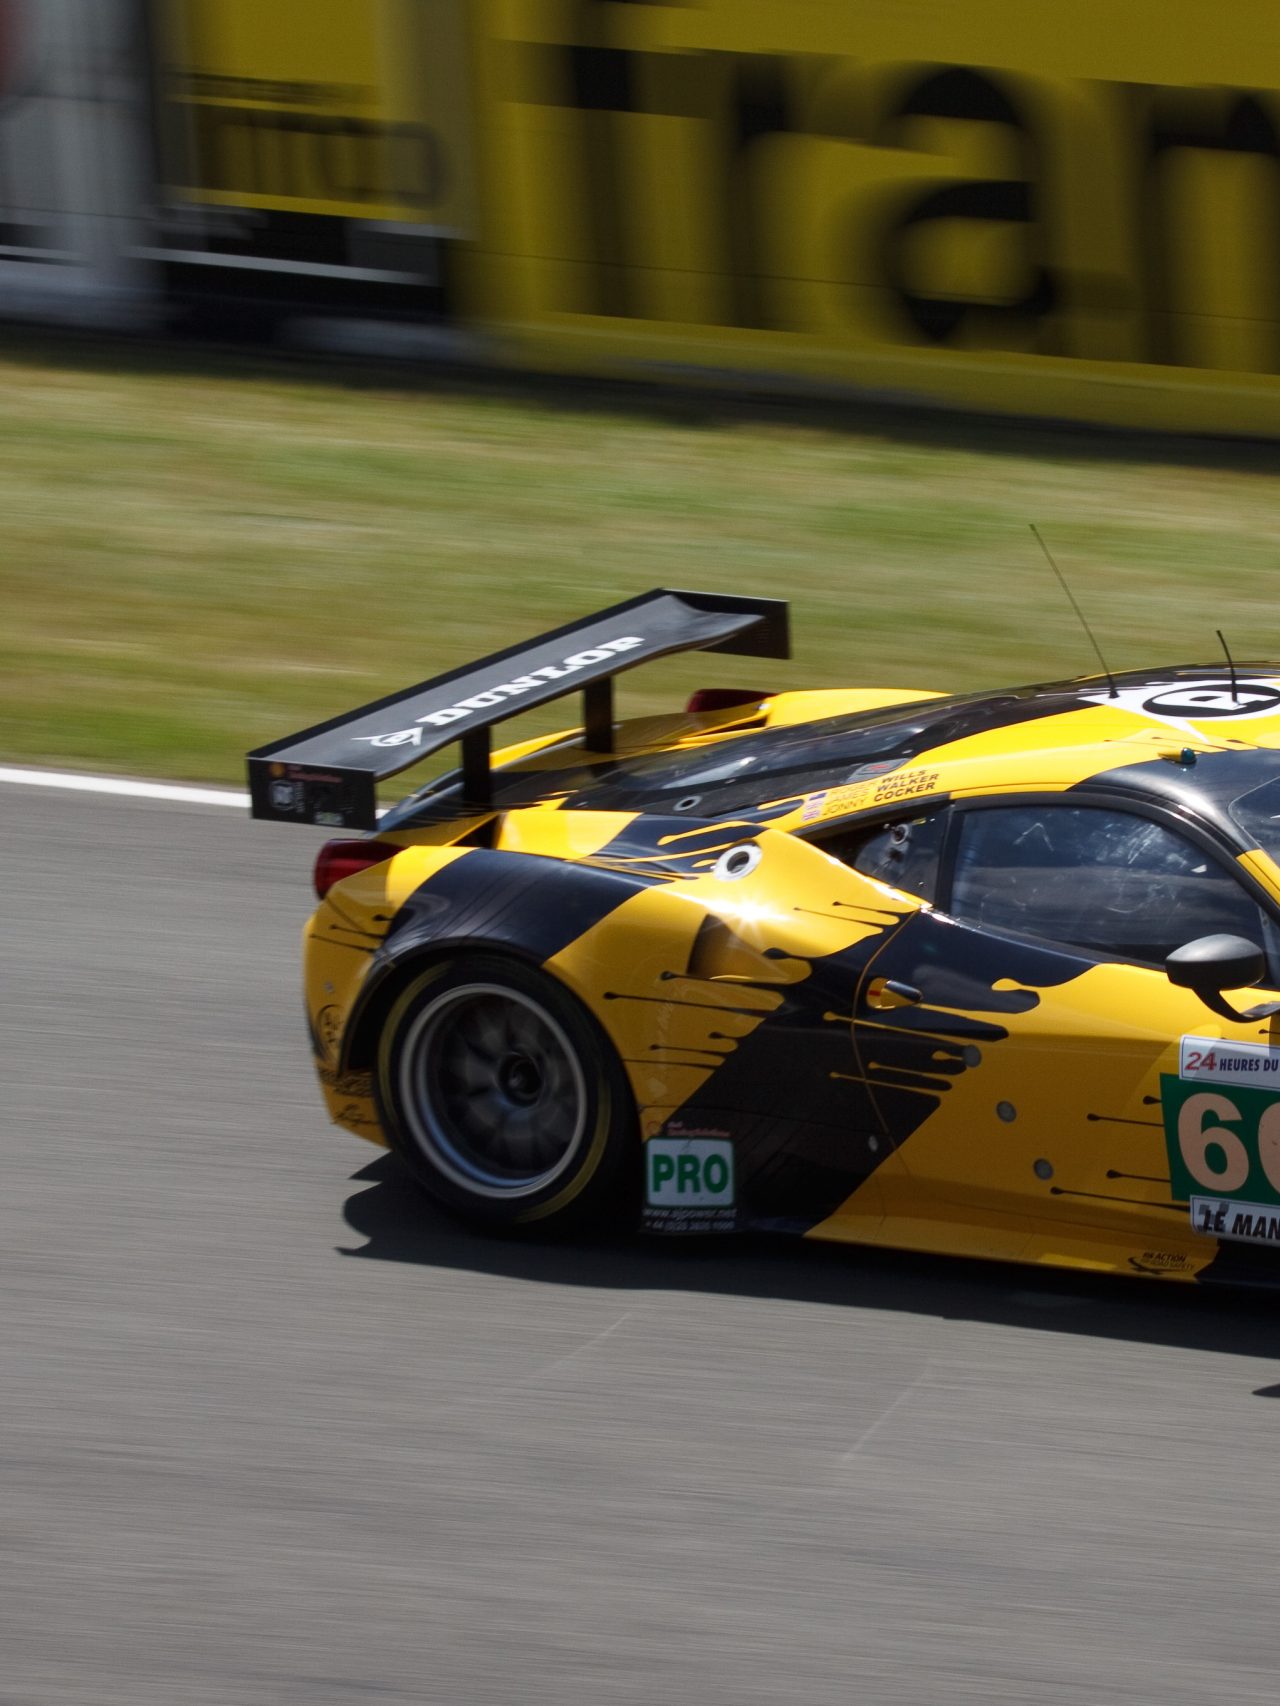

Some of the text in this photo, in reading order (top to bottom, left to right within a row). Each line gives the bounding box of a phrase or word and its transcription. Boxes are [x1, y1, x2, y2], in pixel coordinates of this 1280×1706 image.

[415, 636, 645, 727] DUNLOP
[877, 773, 939, 793] WALKER
[881, 769, 927, 784] WILLS
[874, 782, 936, 803] COCKER
[1184, 1052, 1217, 1071] 24
[1219, 1058, 1260, 1072] HEURES
[1263, 1060, 1279, 1072] DU
[652, 1154, 729, 1194] PRO
